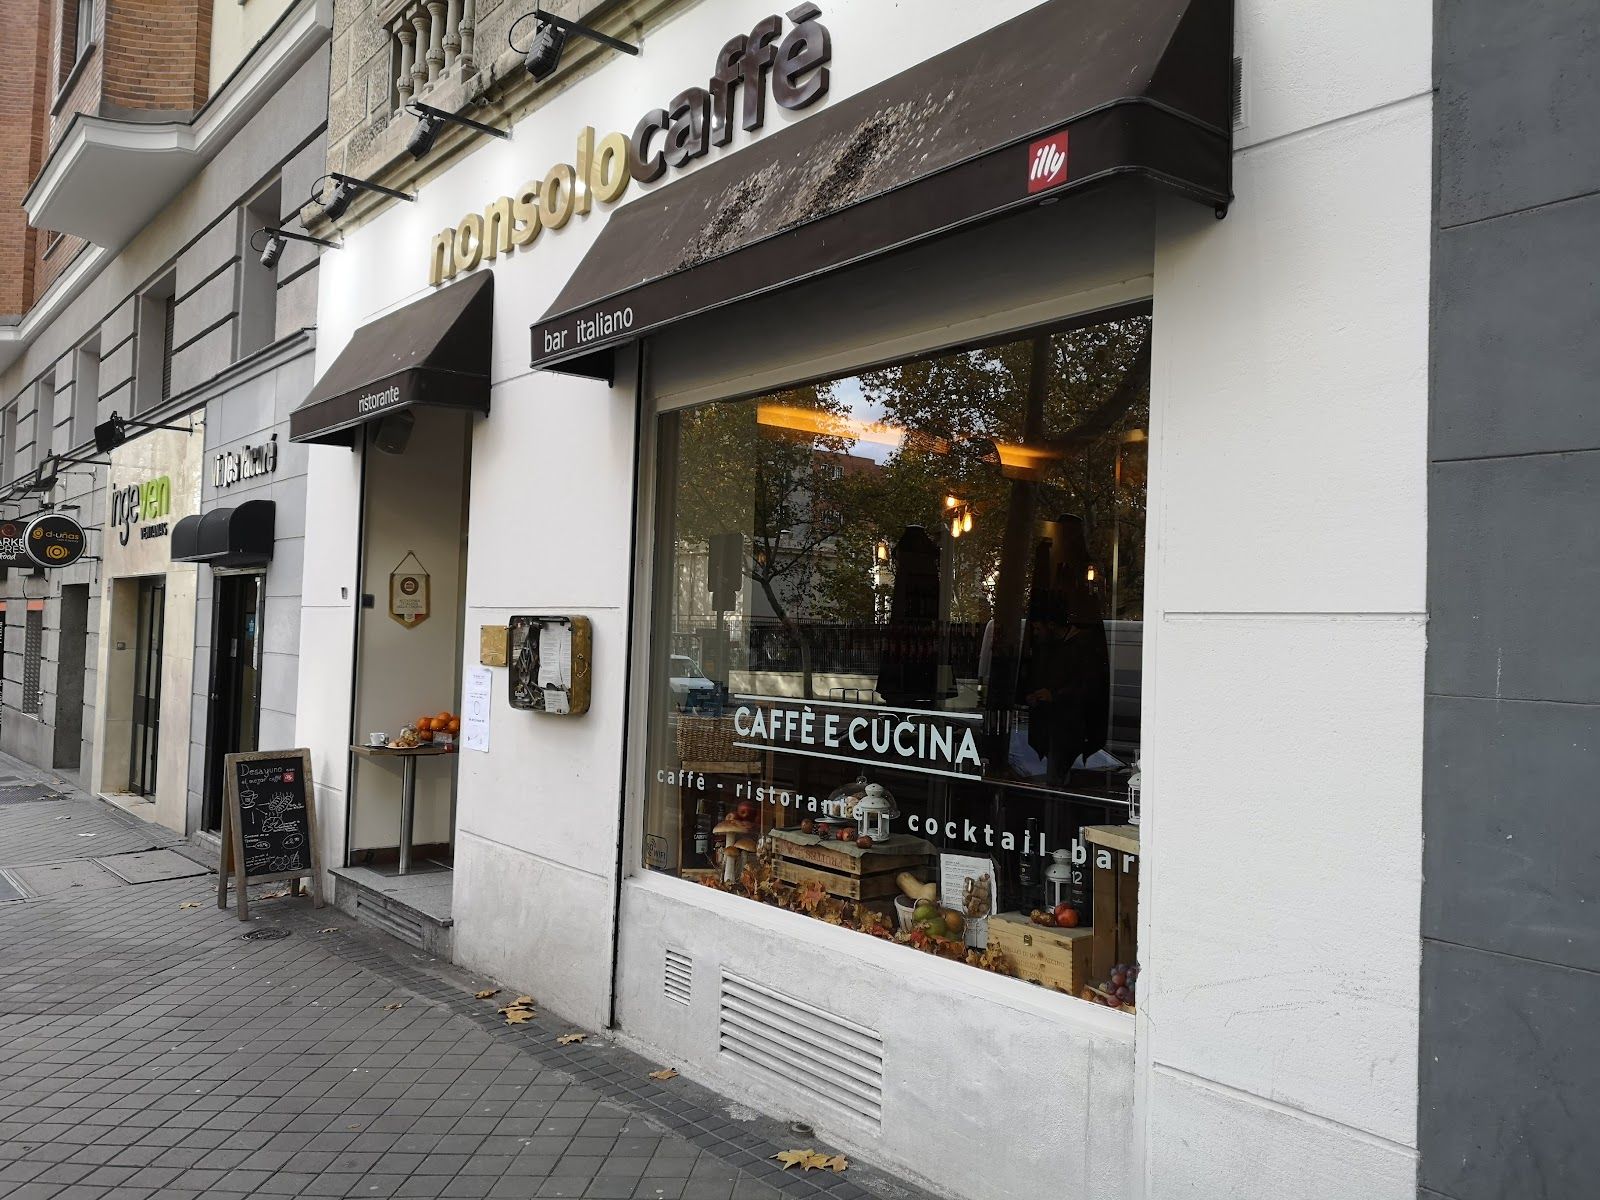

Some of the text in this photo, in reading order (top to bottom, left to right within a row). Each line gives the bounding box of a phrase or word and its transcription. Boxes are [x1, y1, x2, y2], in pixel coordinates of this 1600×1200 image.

[1030, 143, 1066, 183] illy
[544, 307, 633, 353] bar italiano
[358, 385, 400, 413] ristorante
[733, 705, 982, 766] CAFFÈ E CUCINA
[657, 769, 705, 791] caffè
[736, 781, 864, 821] ristorante
[908, 814, 1046, 857] cocktail
[1071, 838, 1135, 874] bar
[1071, 871, 1083, 885] 12
